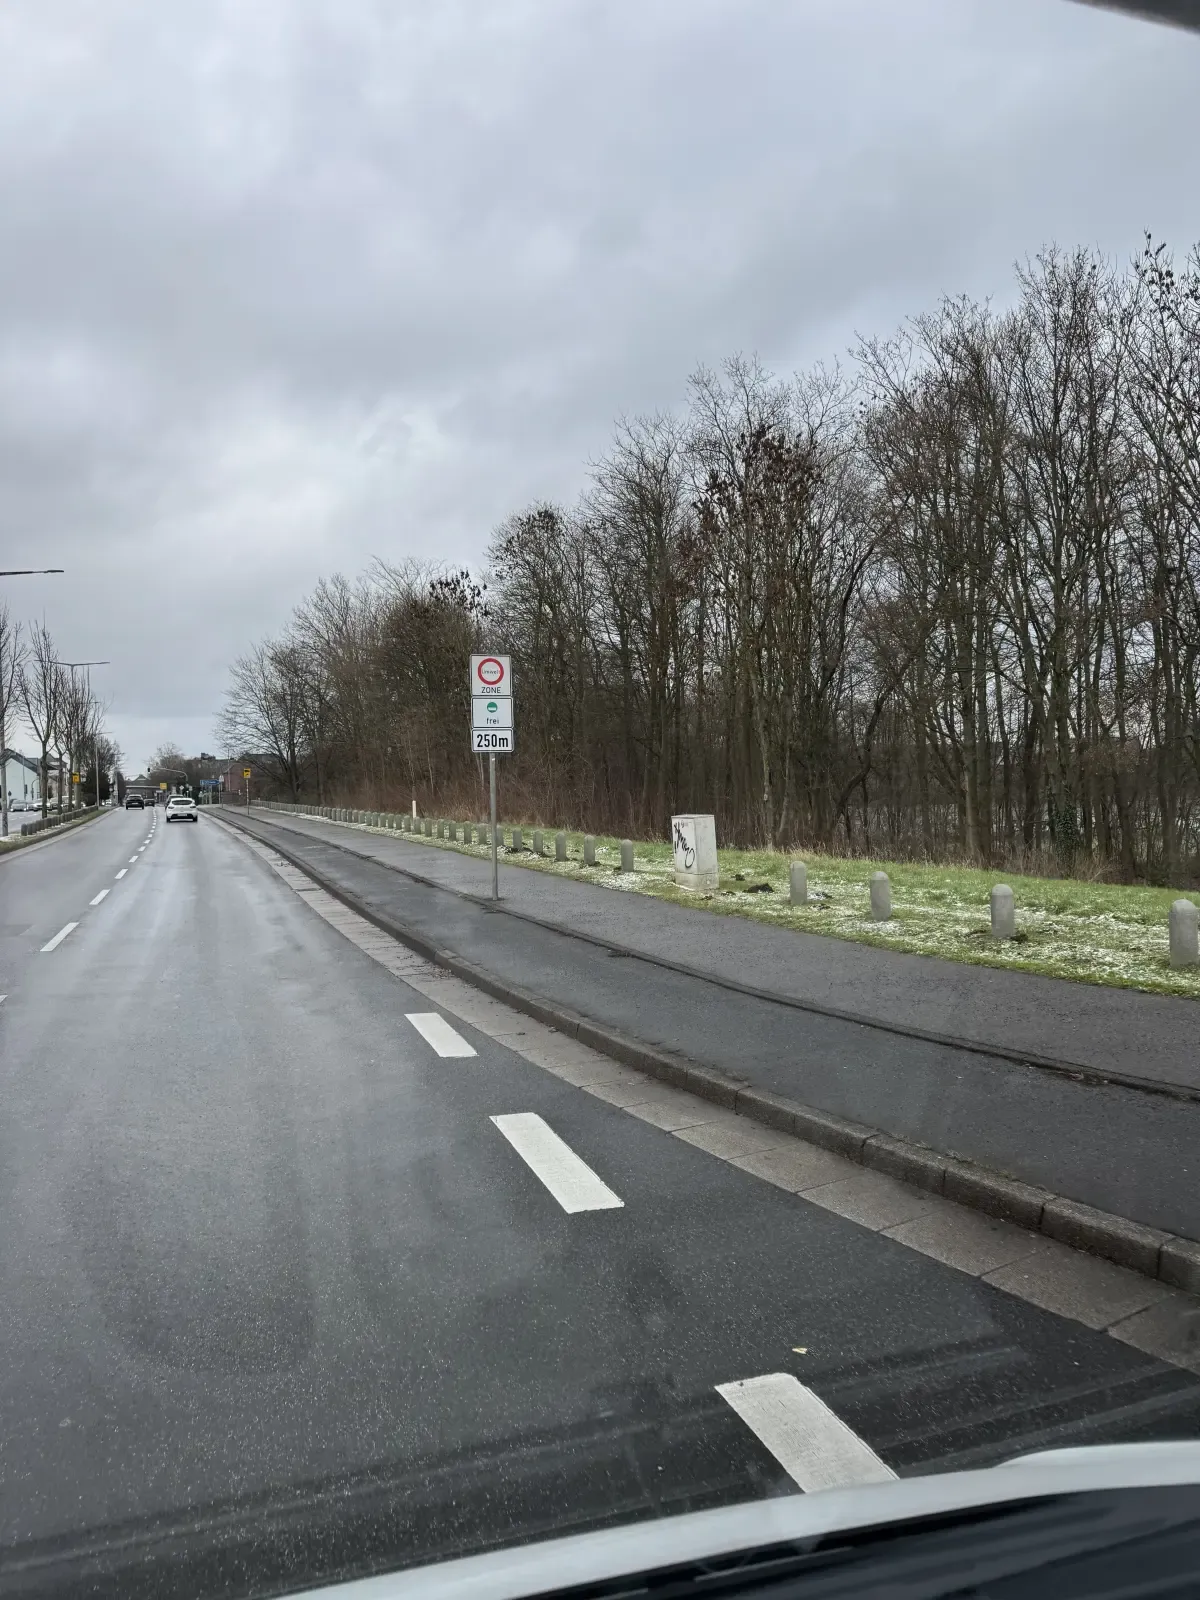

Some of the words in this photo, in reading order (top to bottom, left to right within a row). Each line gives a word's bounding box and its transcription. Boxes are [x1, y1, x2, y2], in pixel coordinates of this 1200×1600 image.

[481, 686, 501, 694] ZONE
[486, 717, 500, 725] frei
[476, 733, 509, 748] 250m
